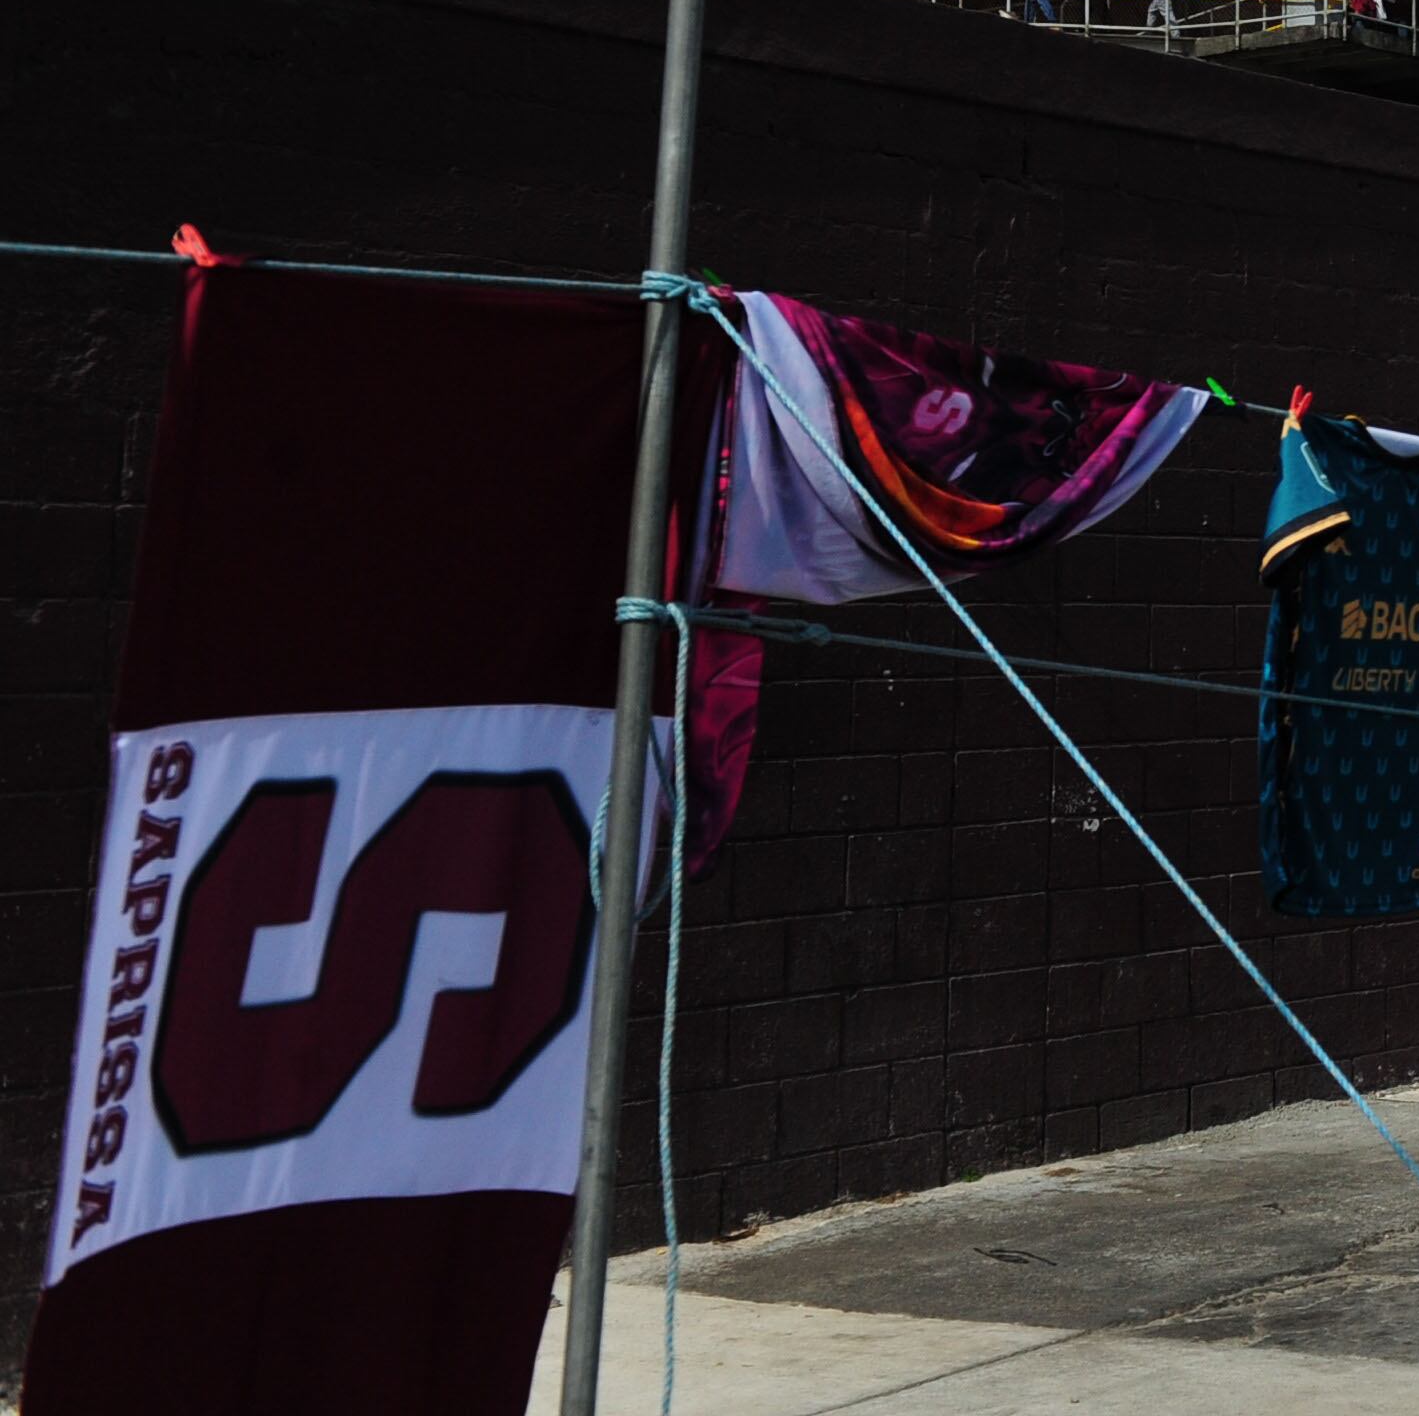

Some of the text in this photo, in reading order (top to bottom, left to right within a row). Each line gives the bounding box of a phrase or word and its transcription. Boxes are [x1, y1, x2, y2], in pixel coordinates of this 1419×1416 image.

[1332, 668, 1416, 692] LIBERTY
[72, 739, 193, 1249] SAPRISSA
[151, 768, 596, 1157] S
